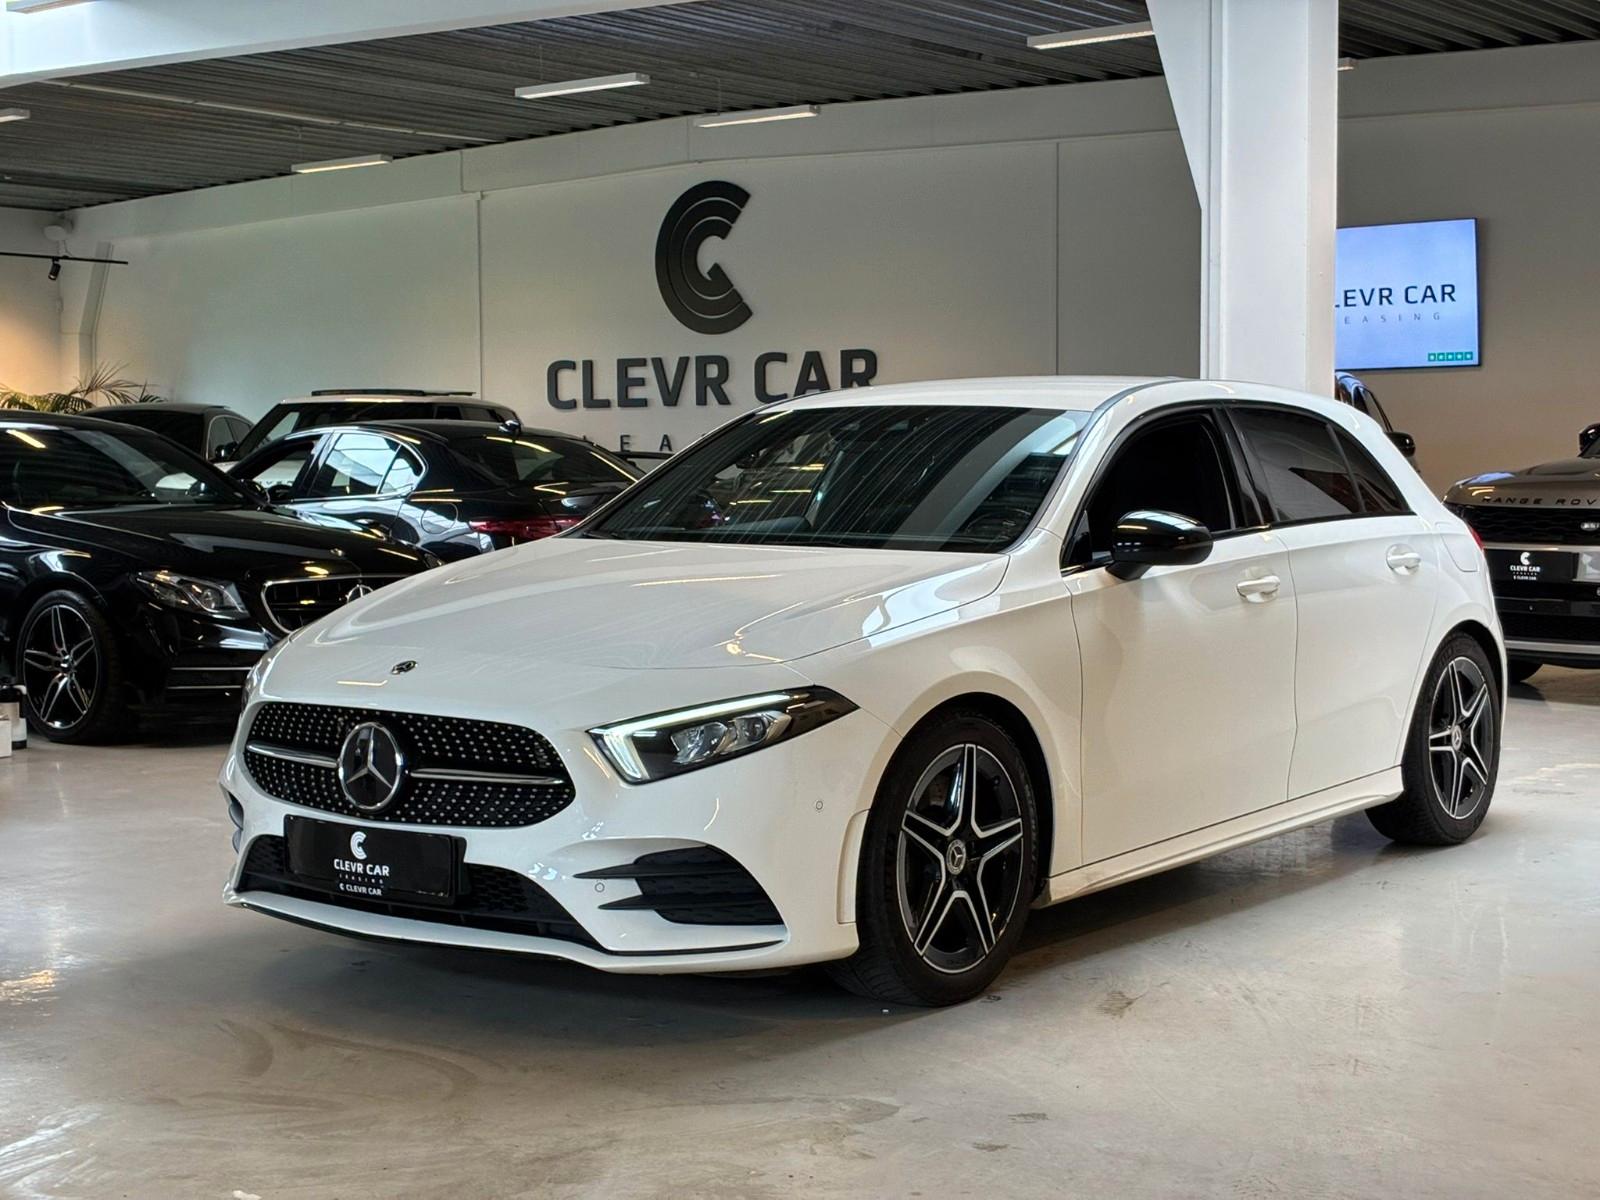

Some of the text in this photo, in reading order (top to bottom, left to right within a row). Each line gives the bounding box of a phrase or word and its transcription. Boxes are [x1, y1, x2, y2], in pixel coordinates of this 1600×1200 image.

[1335, 284, 1456, 308] EVR CAR
[1344, 312, 1441, 325] EASING
[546, 349, 878, 410] CLEVR CAR
[1481, 497, 1543, 505] RANGE
[334, 859, 390, 877] CLEVR CAR
[346, 884, 367, 894] CLEVR
[368, 887, 382, 896] CAR
